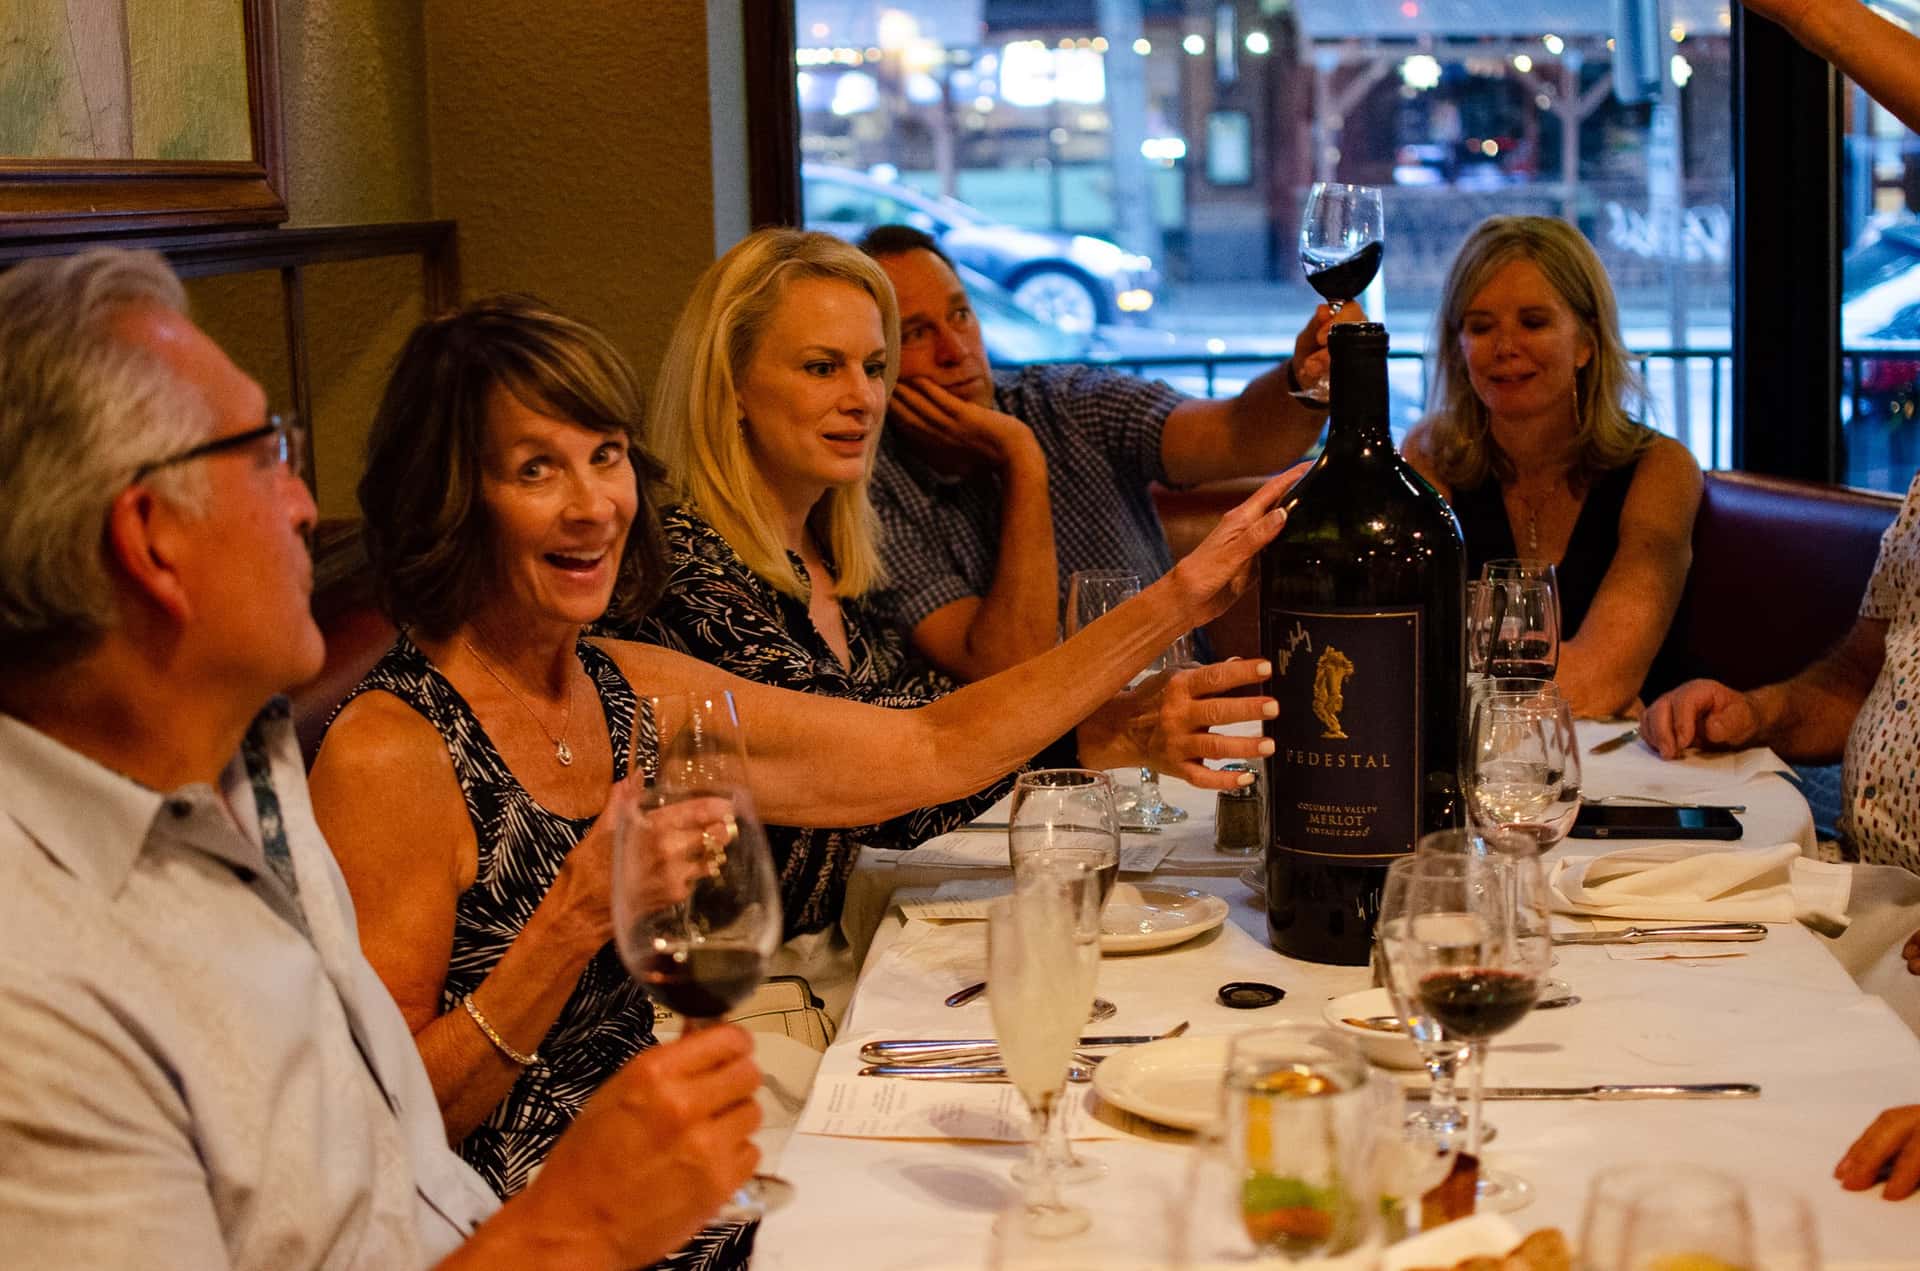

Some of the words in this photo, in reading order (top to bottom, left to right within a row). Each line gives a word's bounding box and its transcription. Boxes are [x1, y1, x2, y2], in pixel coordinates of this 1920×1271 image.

[1297, 802, 1341, 813] COLUMBIA
[1344, 806, 1377, 814] VALLEY
[1310, 815, 1364, 826] MERLOT
[1306, 826, 1341, 836] VINTAGE
